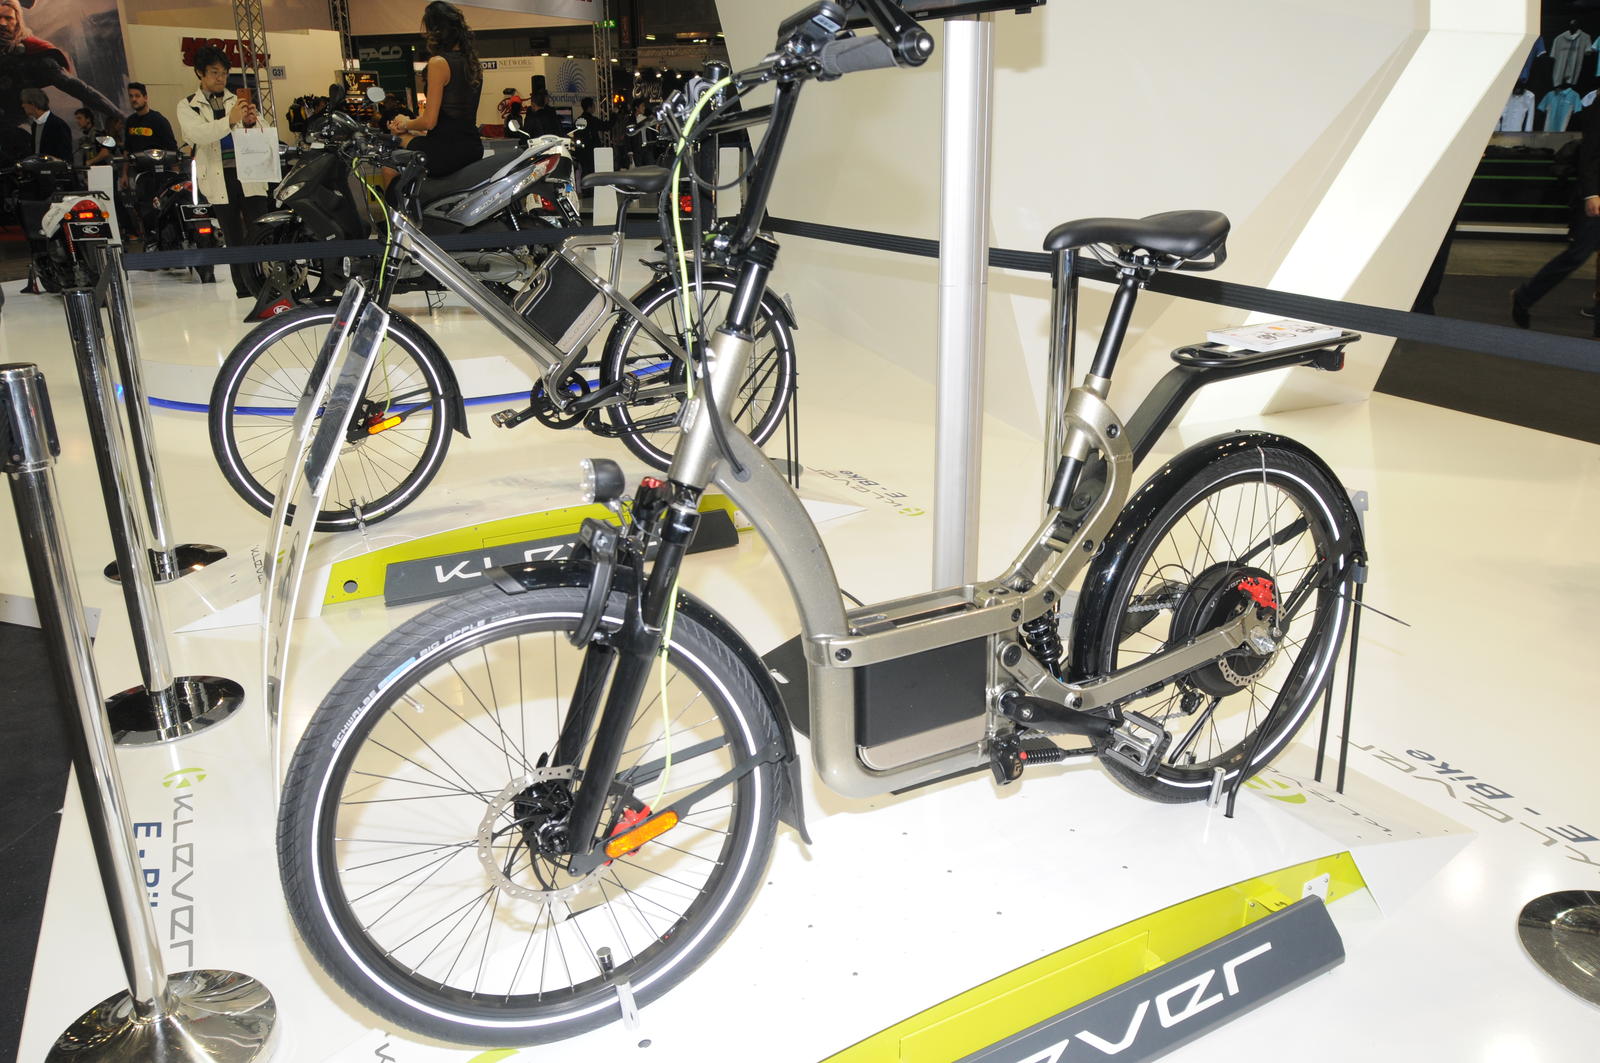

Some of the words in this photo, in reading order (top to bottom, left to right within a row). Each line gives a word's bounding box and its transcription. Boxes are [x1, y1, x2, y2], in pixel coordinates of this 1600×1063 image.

[272, 68, 284, 76] G31
[359, 45, 403, 61] FACO
[420, 641, 440, 657] BIG
[444, 619, 486, 642] APPLE
[332, 689, 377, 750] SCHWALBE
[1405, 749, 1515, 799] Bike
